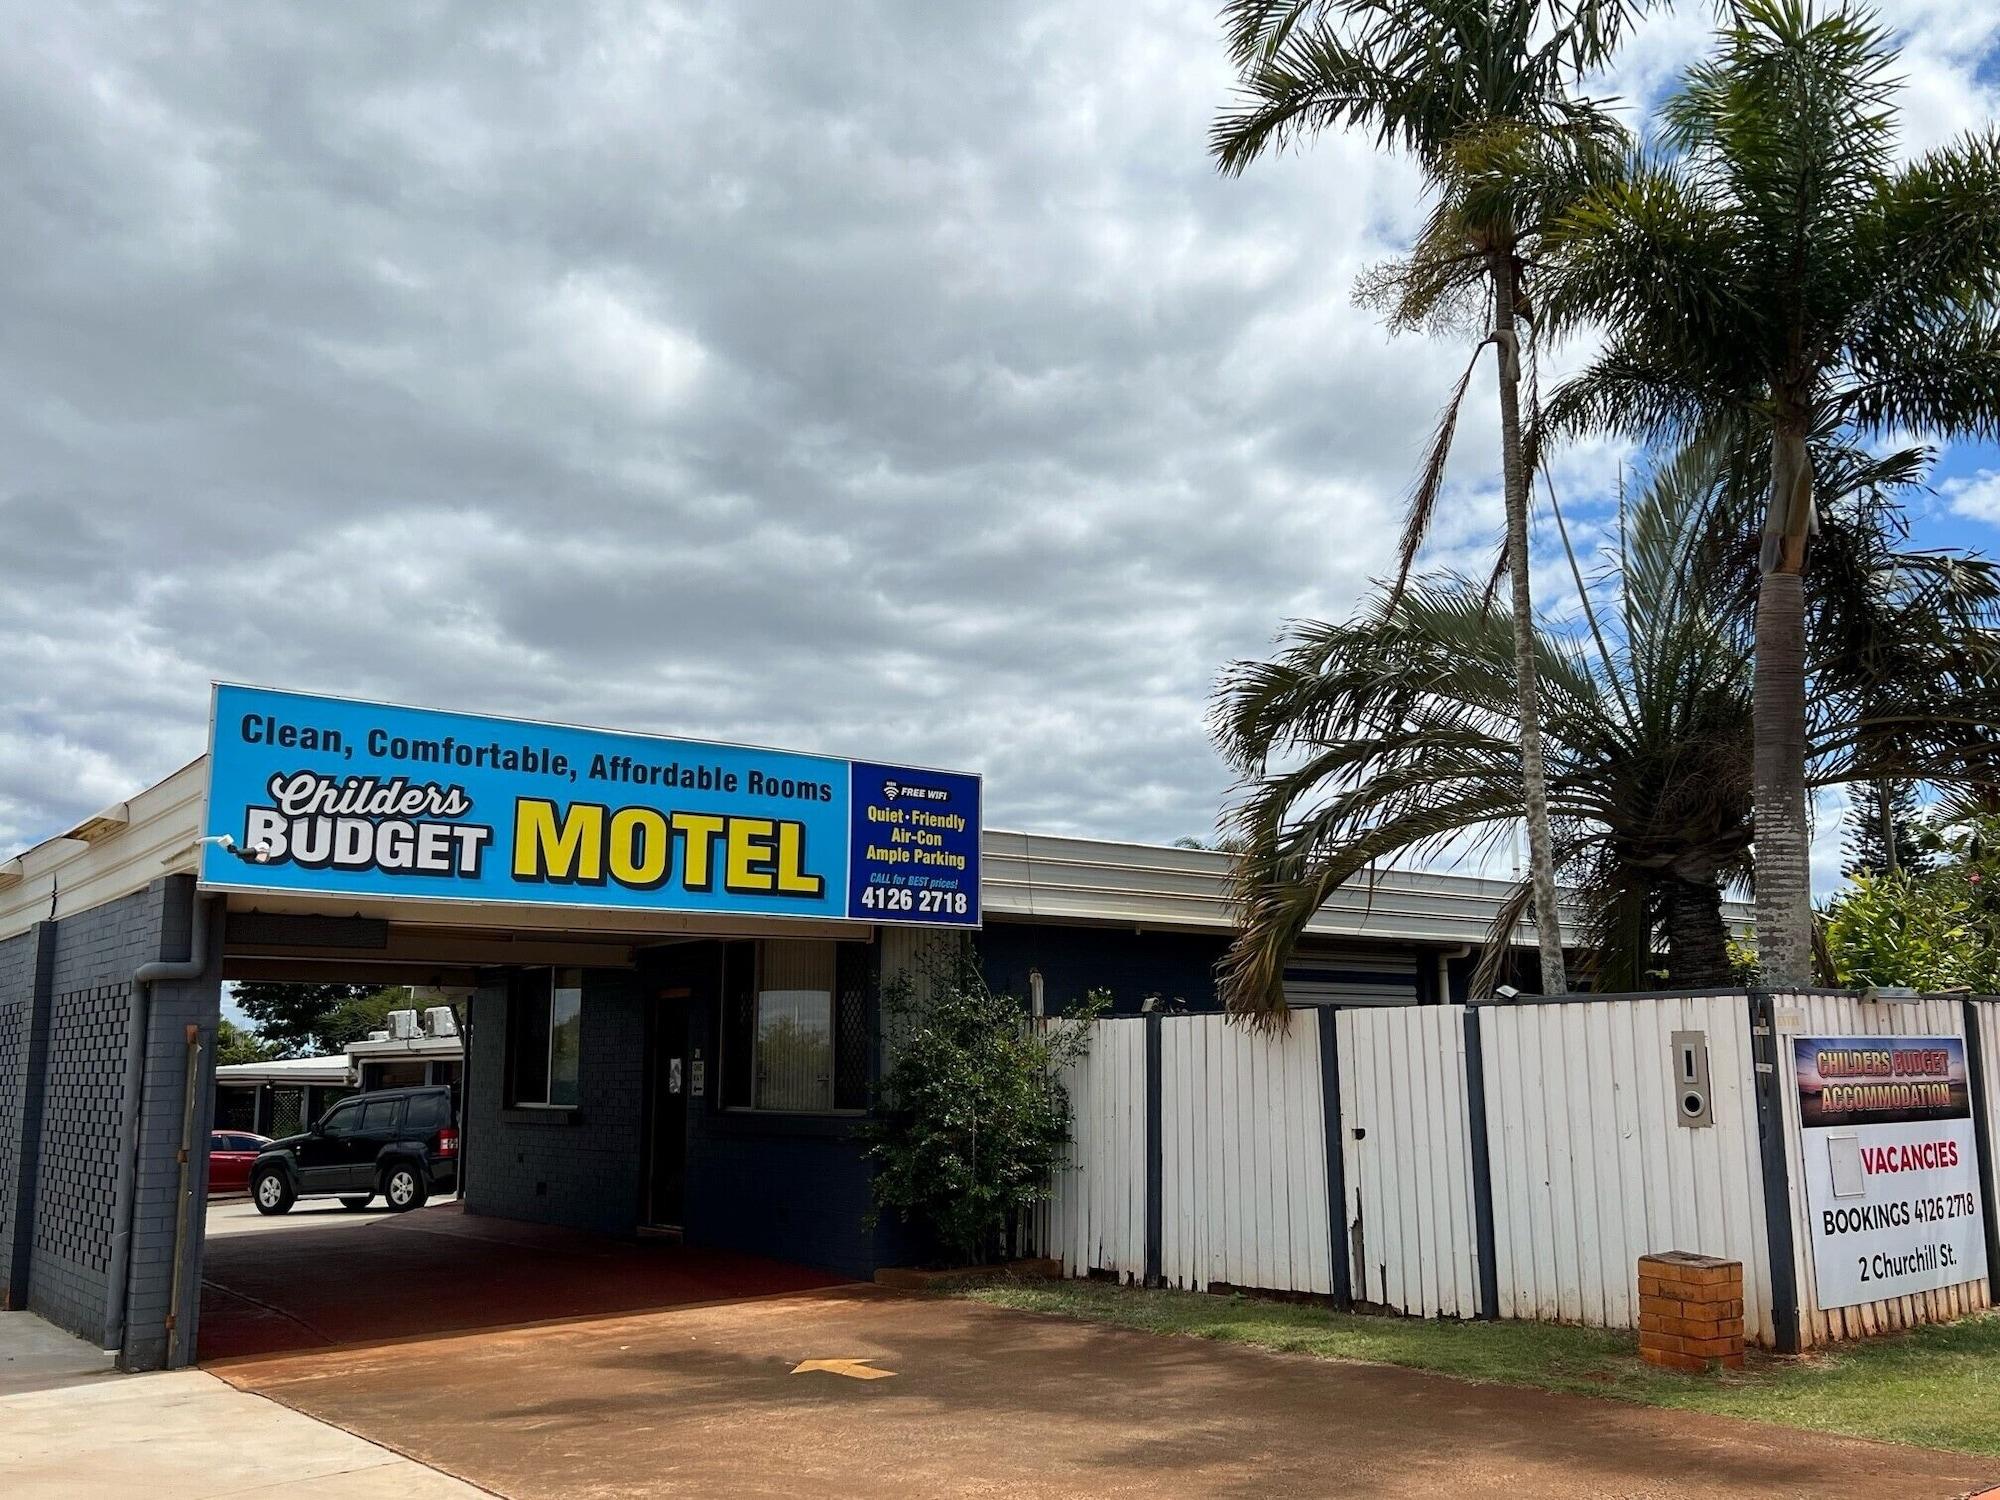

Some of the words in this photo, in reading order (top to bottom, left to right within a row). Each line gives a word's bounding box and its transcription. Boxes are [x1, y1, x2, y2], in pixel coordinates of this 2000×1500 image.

[241, 713, 353, 760] Clean,
[367, 728, 578, 784] Comfortable,
[588, 754, 738, 793] Affordable
[748, 770, 833, 802] Rooms
[270, 772, 470, 817] Childers
[901, 787, 926, 798] FREE
[927, 790, 948, 801] WIFI
[867, 805, 904, 823] Quiet
[911, 809, 966, 833] Friendly
[245, 808, 489, 873] BUDGET
[511, 796, 825, 897] MOTEL
[891, 827, 943, 846] Air-Con
[866, 844, 911, 864] Ample
[914, 848, 966, 870] Parking
[870, 872, 891, 884] CALL
[893, 874, 906, 885] for
[908, 876, 929, 887] BEST
[930, 878, 958, 890] prices!
[861, 886, 913, 911] 4126
[918, 890, 967, 914] 2718
[1817, 1050, 1892, 1078] CHILDERS
[1892, 1048, 1949, 1076] BUDGET
[1821, 1082, 1951, 1112] ACCOMMODATION
[1860, 1141, 1959, 1175] VACANCIES
[1822, 1201, 1910, 1236] BOOKINGS
[1914, 1197, 1944, 1223] 4126
[1946, 1192, 1975, 1219] 2718
[1858, 1256, 1870, 1282] 2
[1872, 1243, 1938, 1279] Churchill
[1939, 1243, 1958, 1267] St.
